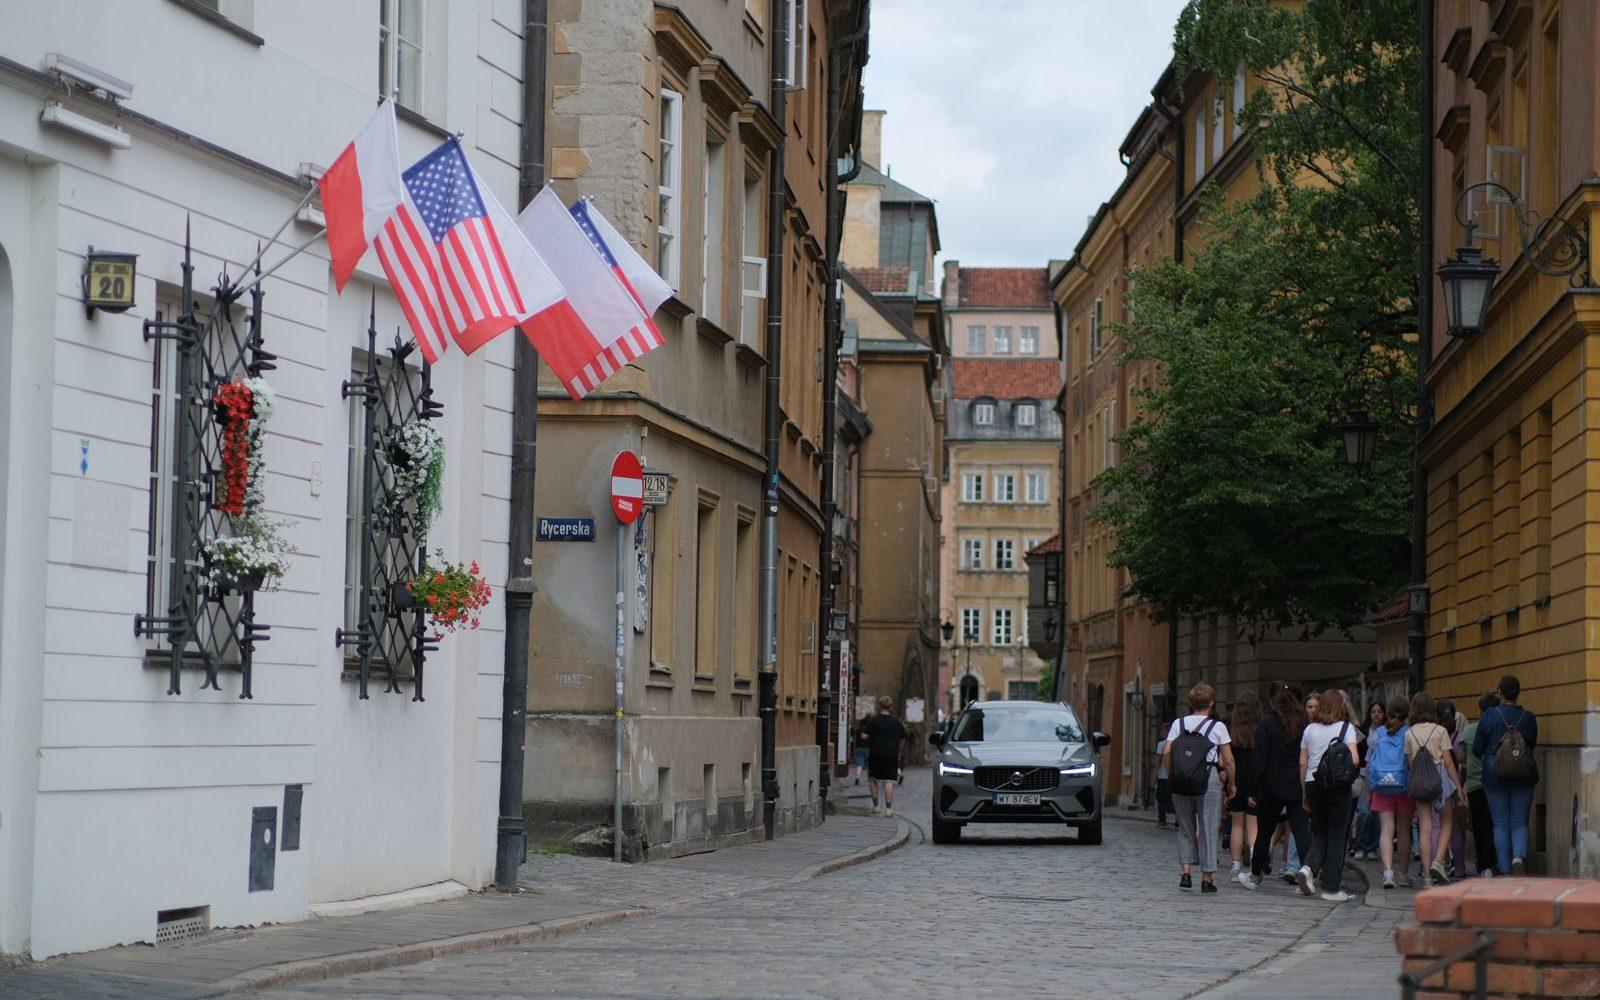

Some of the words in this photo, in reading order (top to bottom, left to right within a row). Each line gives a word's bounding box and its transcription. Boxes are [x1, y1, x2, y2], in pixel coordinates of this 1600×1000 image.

[99, 275, 124, 298] 20
[541, 519, 590, 539] Rycerska
[998, 795, 1010, 803] WY
